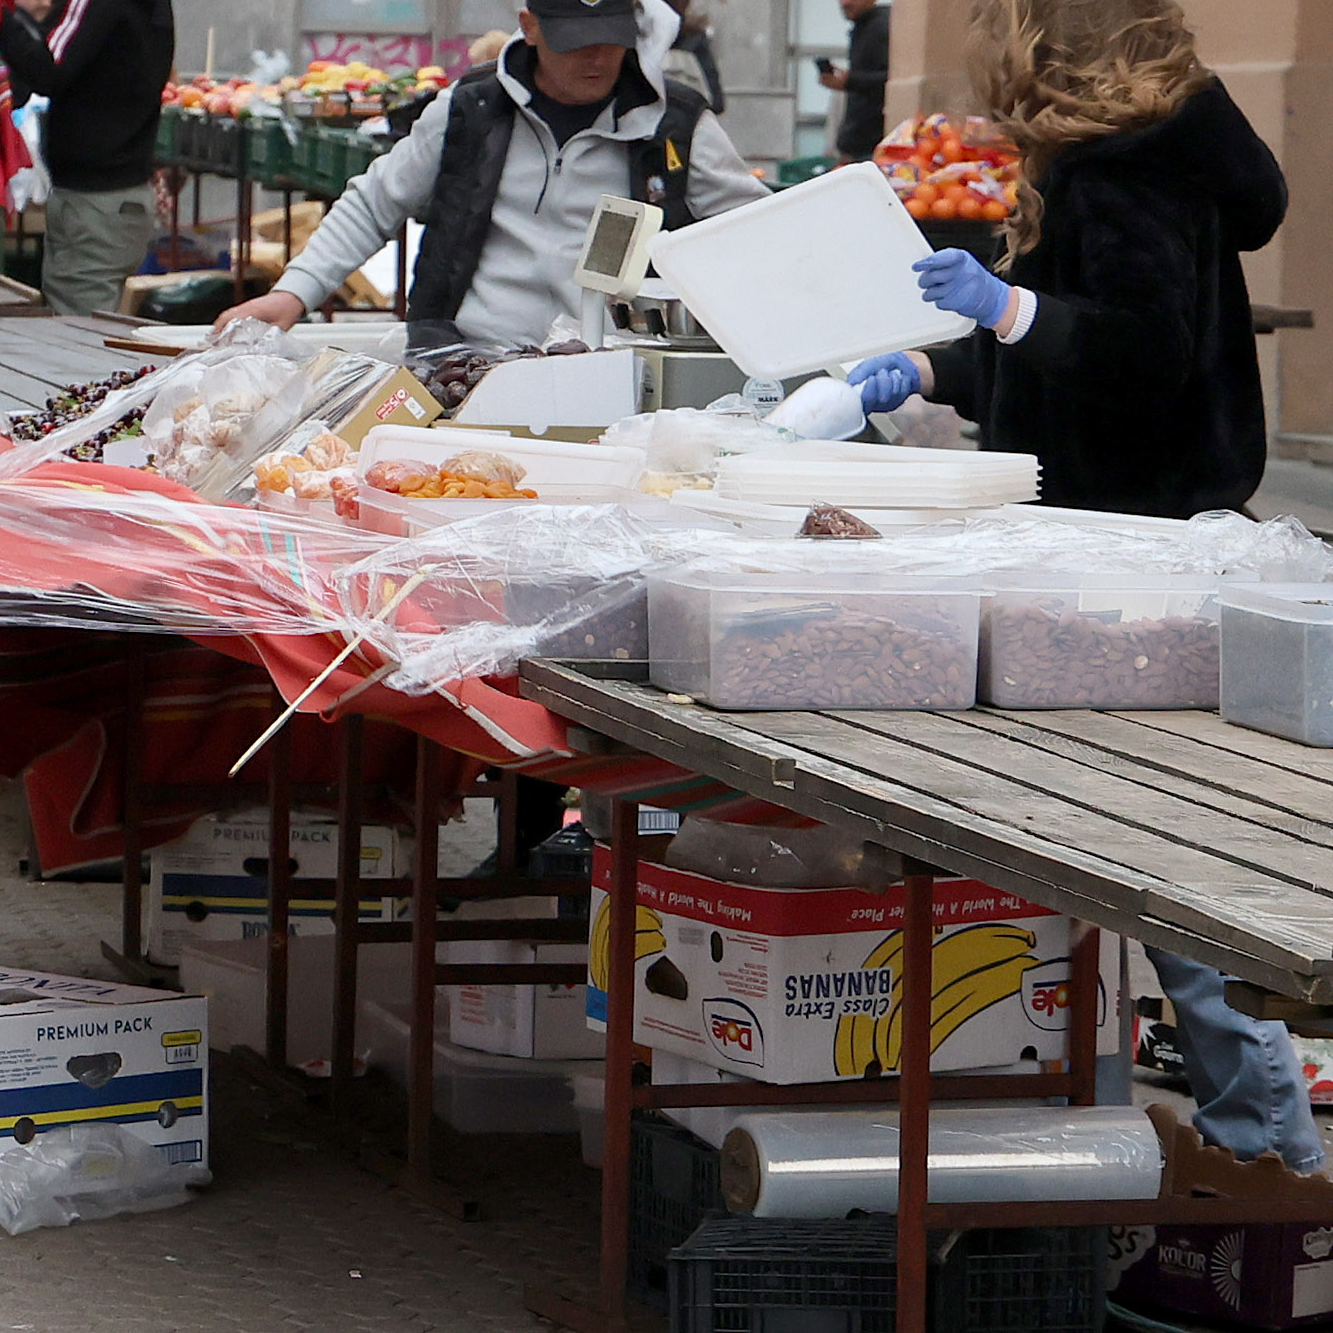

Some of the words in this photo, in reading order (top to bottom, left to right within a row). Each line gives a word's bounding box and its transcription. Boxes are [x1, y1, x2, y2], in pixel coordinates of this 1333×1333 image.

[291, 829, 331, 843] PACK
[667, 890, 695, 910] World
[696, 897, 714, 915] The
[717, 898, 752, 922] Making
[949, 901, 957, 914] A
[962, 897, 995, 915] World
[999, 896, 1021, 911] The
[851, 906, 885, 922] Place
[785, 969, 890, 1001] BANANAS
[785, 999, 835, 1020] Extra
[843, 997, 890, 1017] Class
[37, 1022, 108, 1041] PREMIUM
[115, 1017, 153, 1034] PACK
[711, 1019, 753, 1052] Dole
